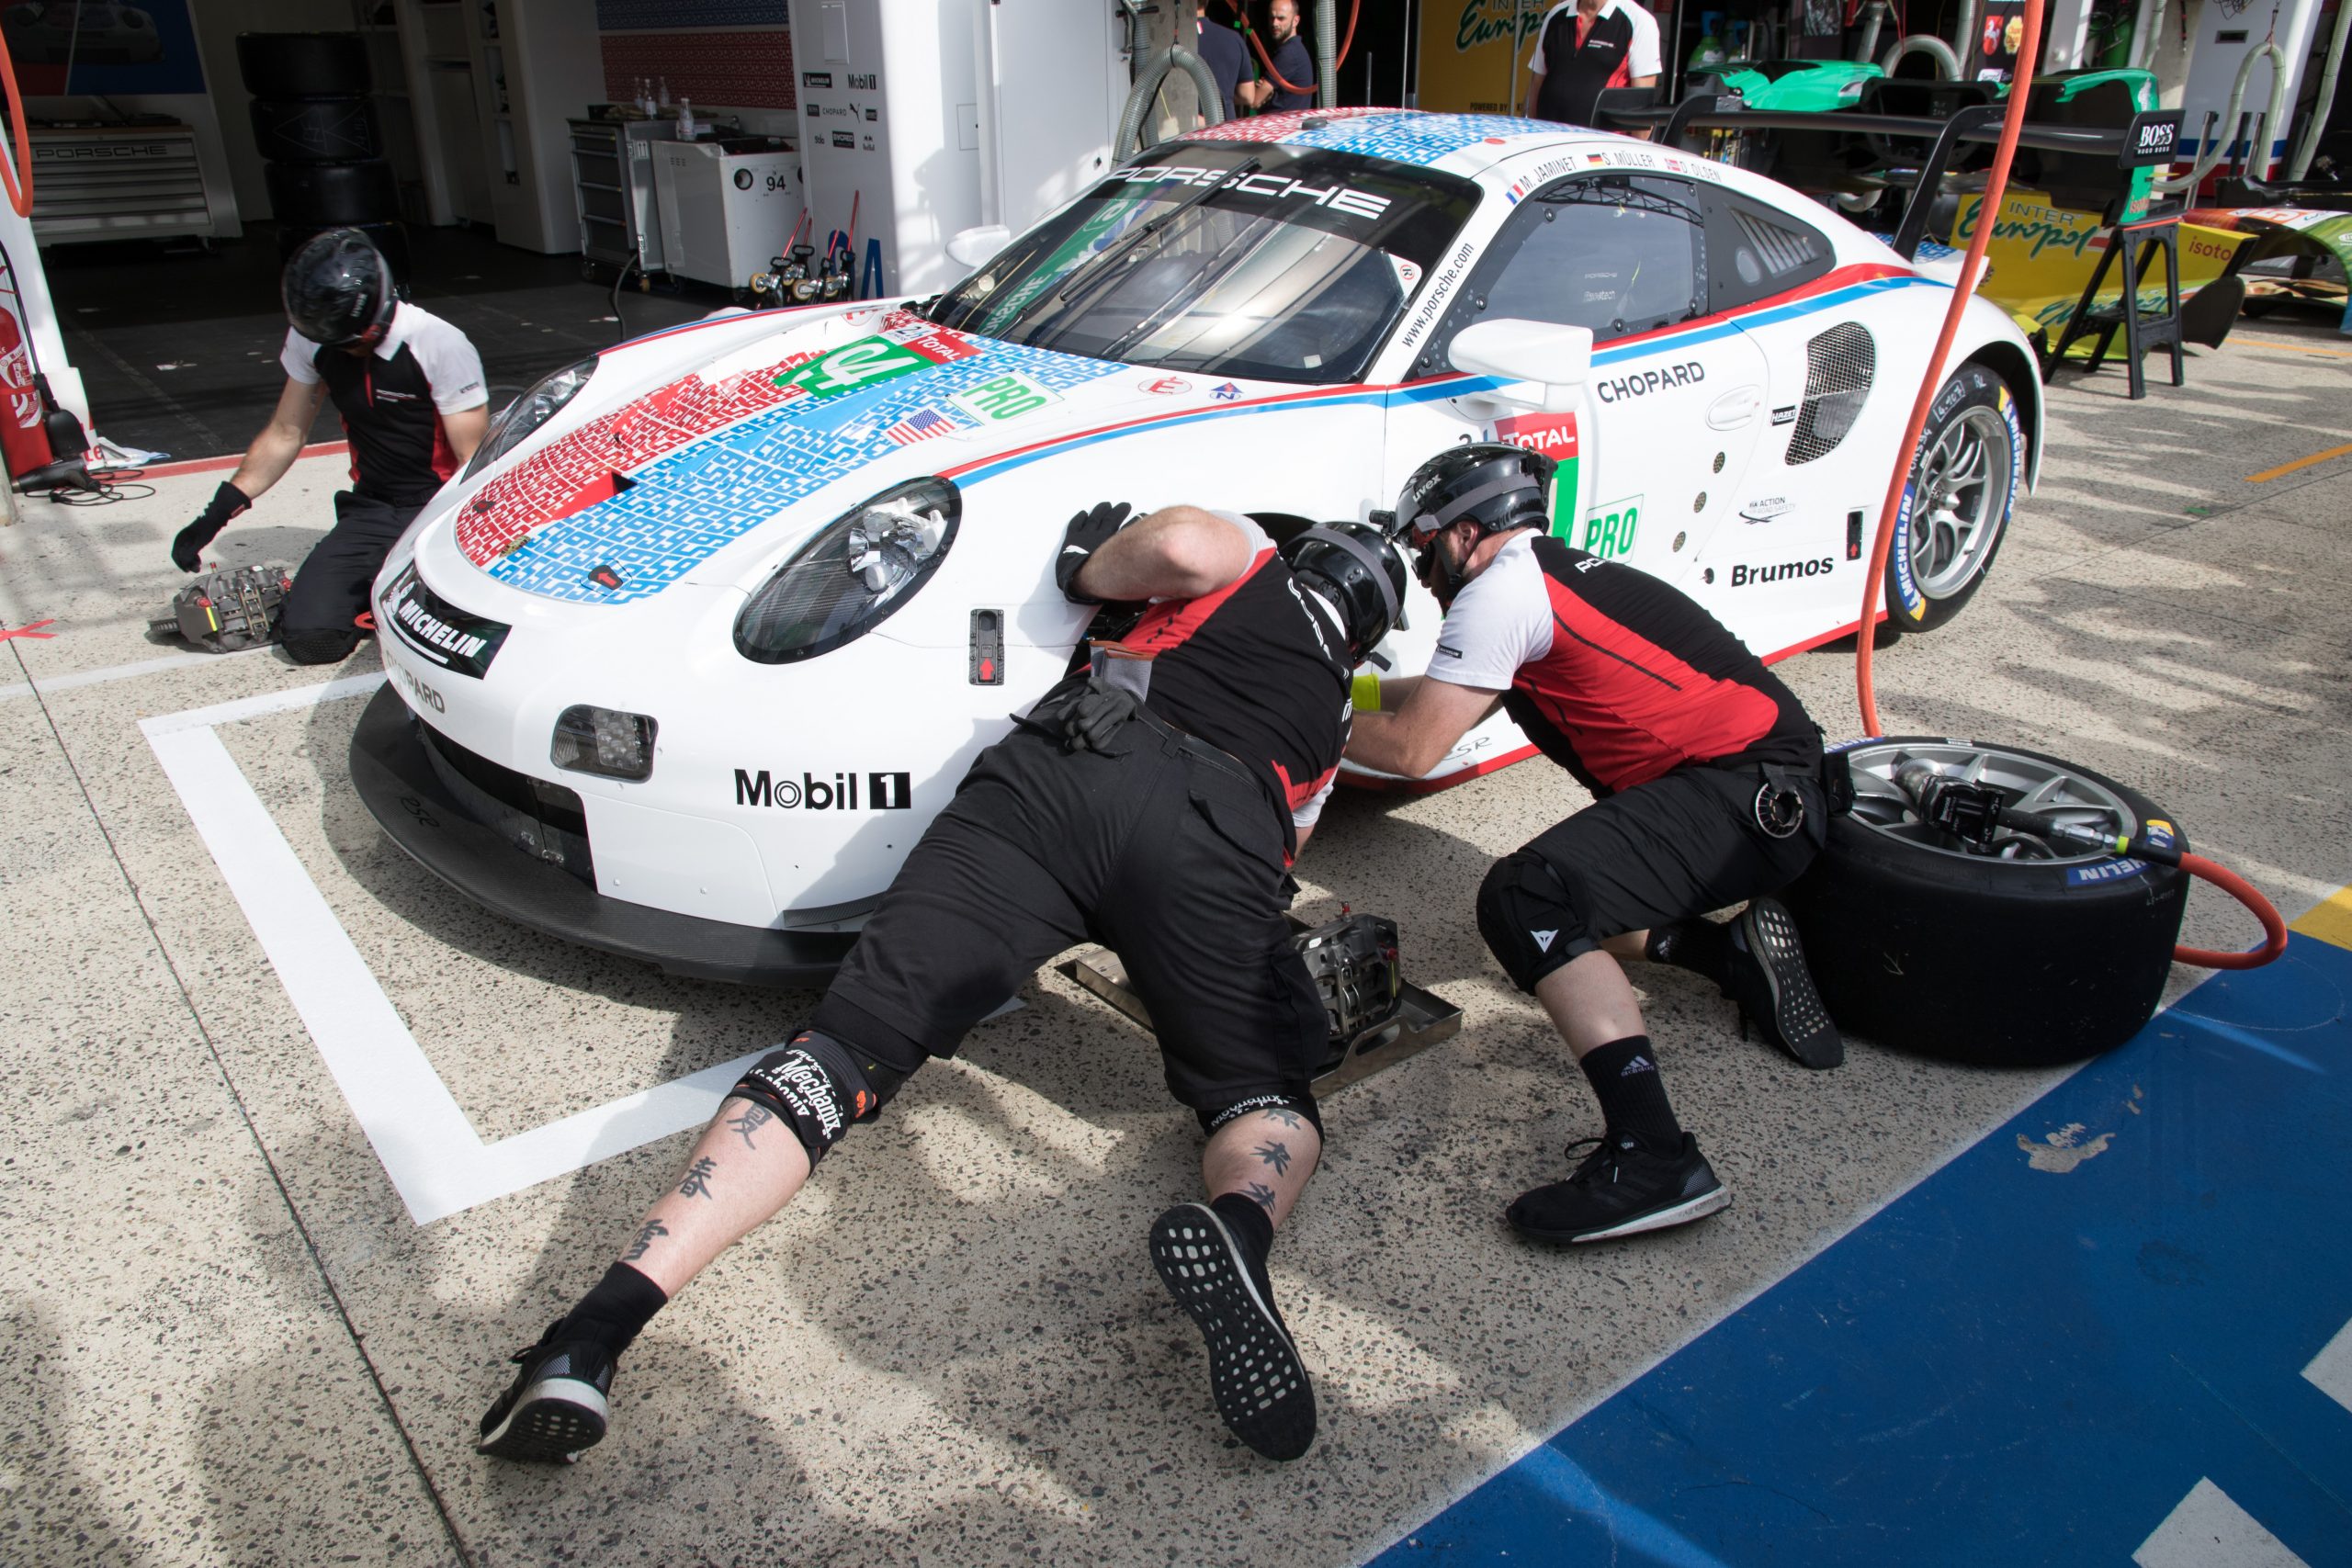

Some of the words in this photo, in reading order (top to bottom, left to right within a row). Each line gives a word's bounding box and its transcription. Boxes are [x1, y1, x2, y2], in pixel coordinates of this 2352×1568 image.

[848, 73, 868, 89] Mobil
[822, 107, 846, 116] CHOPARD
[1470, 103, 1498, 111] POWERED
[2139, 124, 2174, 147] BOSS
[36, 145, 167, 159] PORSCHE
[1616, 150, 1656, 168] MÜLLER
[1536, 156, 1577, 182] JAMINET
[766, 175, 787, 192] 94
[1102, 165, 1393, 220] PORSCHE
[2009, 201, 2075, 227] INTER
[1401, 242, 1476, 349] www.porsche.com
[918, 335, 964, 360] TOTAL
[1597, 361, 1706, 403] CHOPARD
[961, 376, 1048, 420] PRO
[1772, 408, 1797, 423] HAZET
[1502, 425, 1577, 450] TOTAL
[1412, 473, 1443, 502] uvex
[1759, 496, 1786, 507] ACTION
[1584, 507, 1639, 558] PRO
[1896, 492, 1914, 597] MICHELIN
[1731, 556, 1835, 588] Brumos
[398, 598, 488, 659] MICHELIN
[734, 768, 858, 810] Mobil
[775, 1056, 842, 1135] Mechanix
